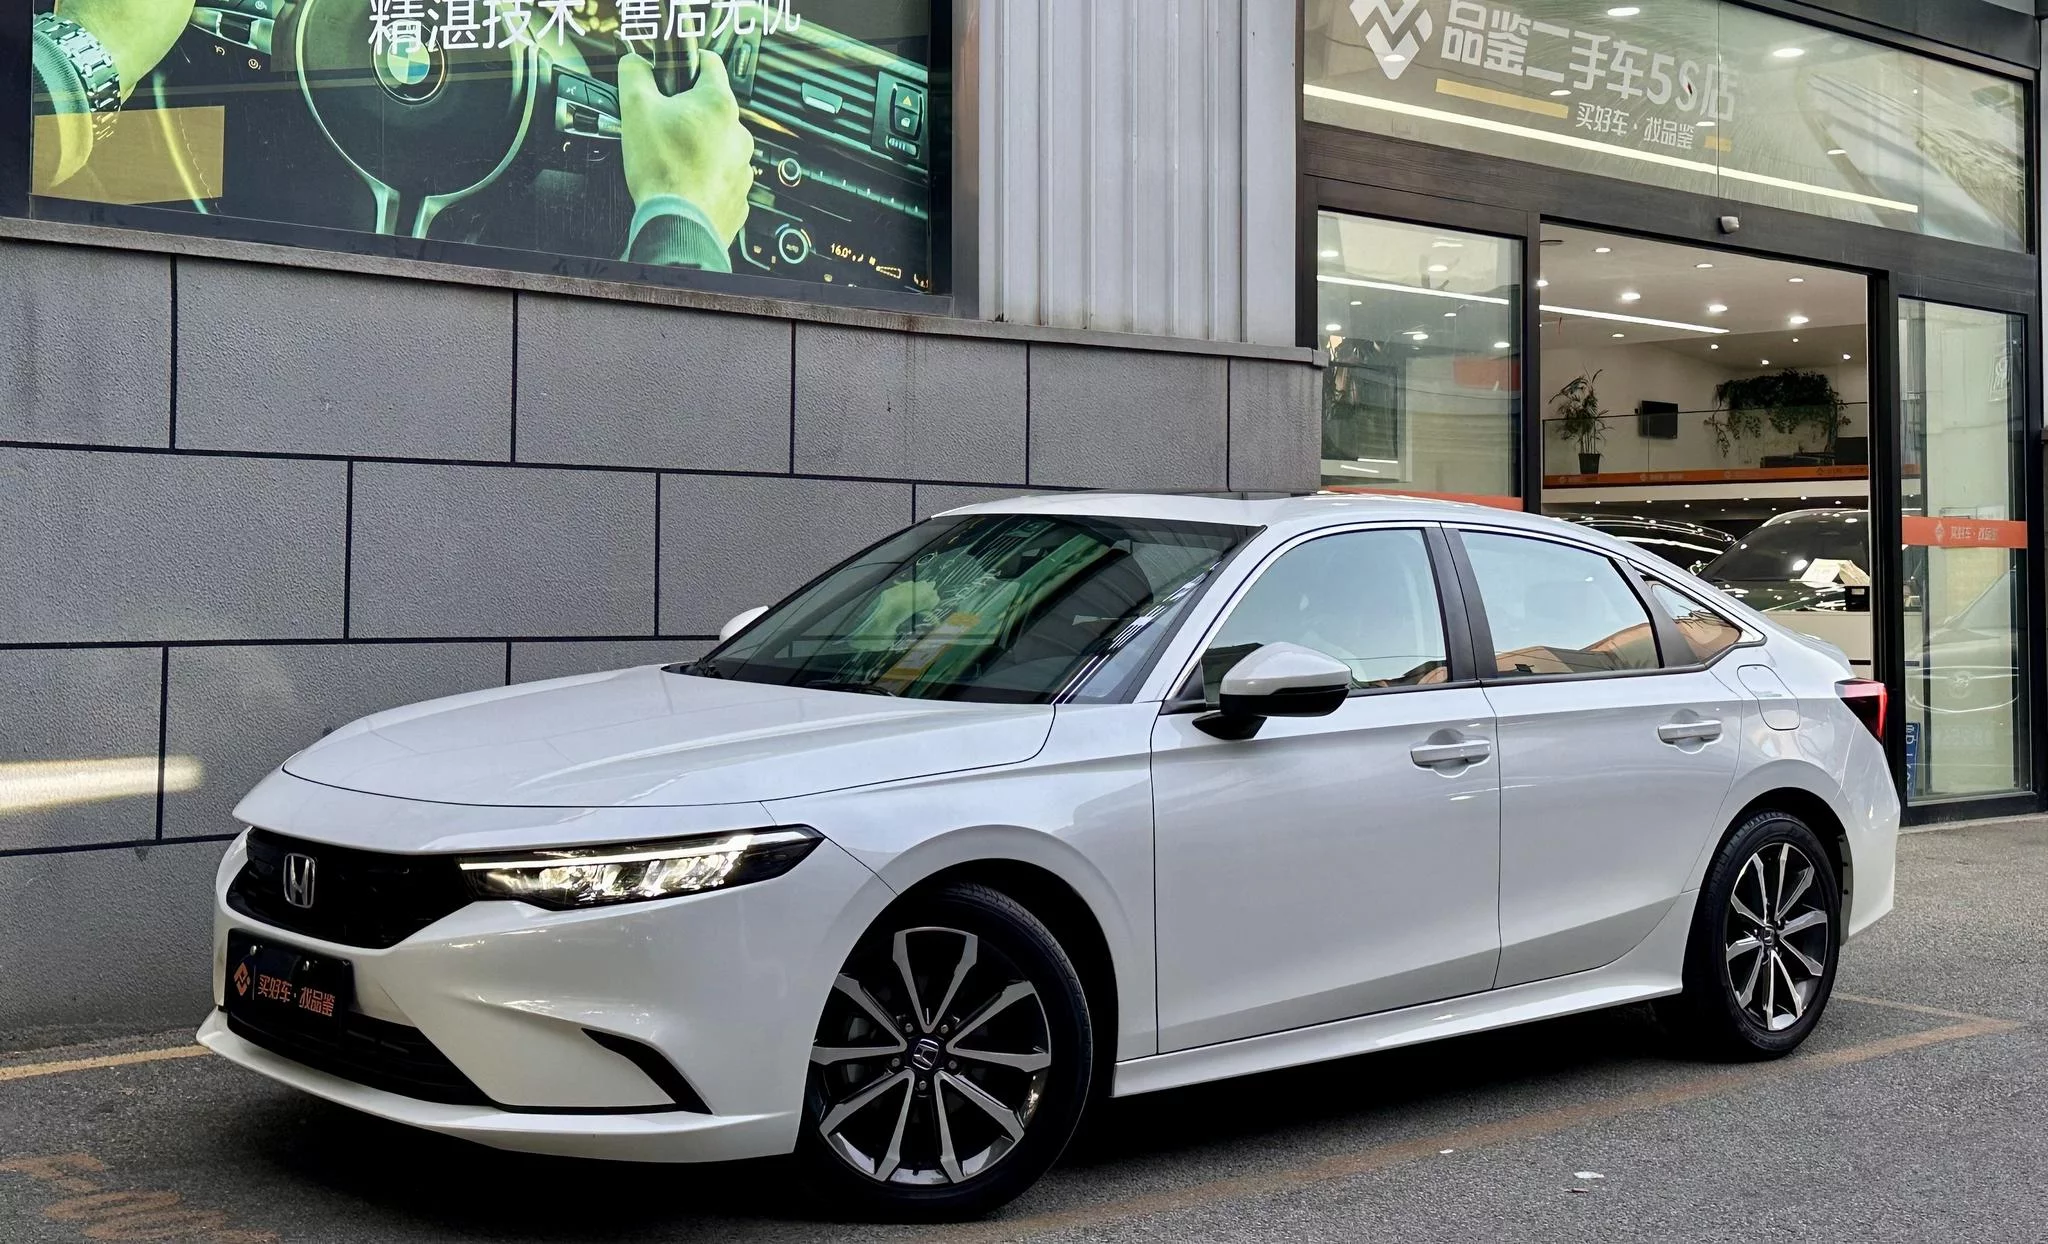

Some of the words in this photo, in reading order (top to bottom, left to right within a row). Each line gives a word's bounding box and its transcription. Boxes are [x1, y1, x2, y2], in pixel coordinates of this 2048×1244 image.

[368, 0, 586, 55] 精湛技术
[615, 0, 801, 40] 售后无忧
[1440, 0, 1739, 122] 品鉴二手车5S店
